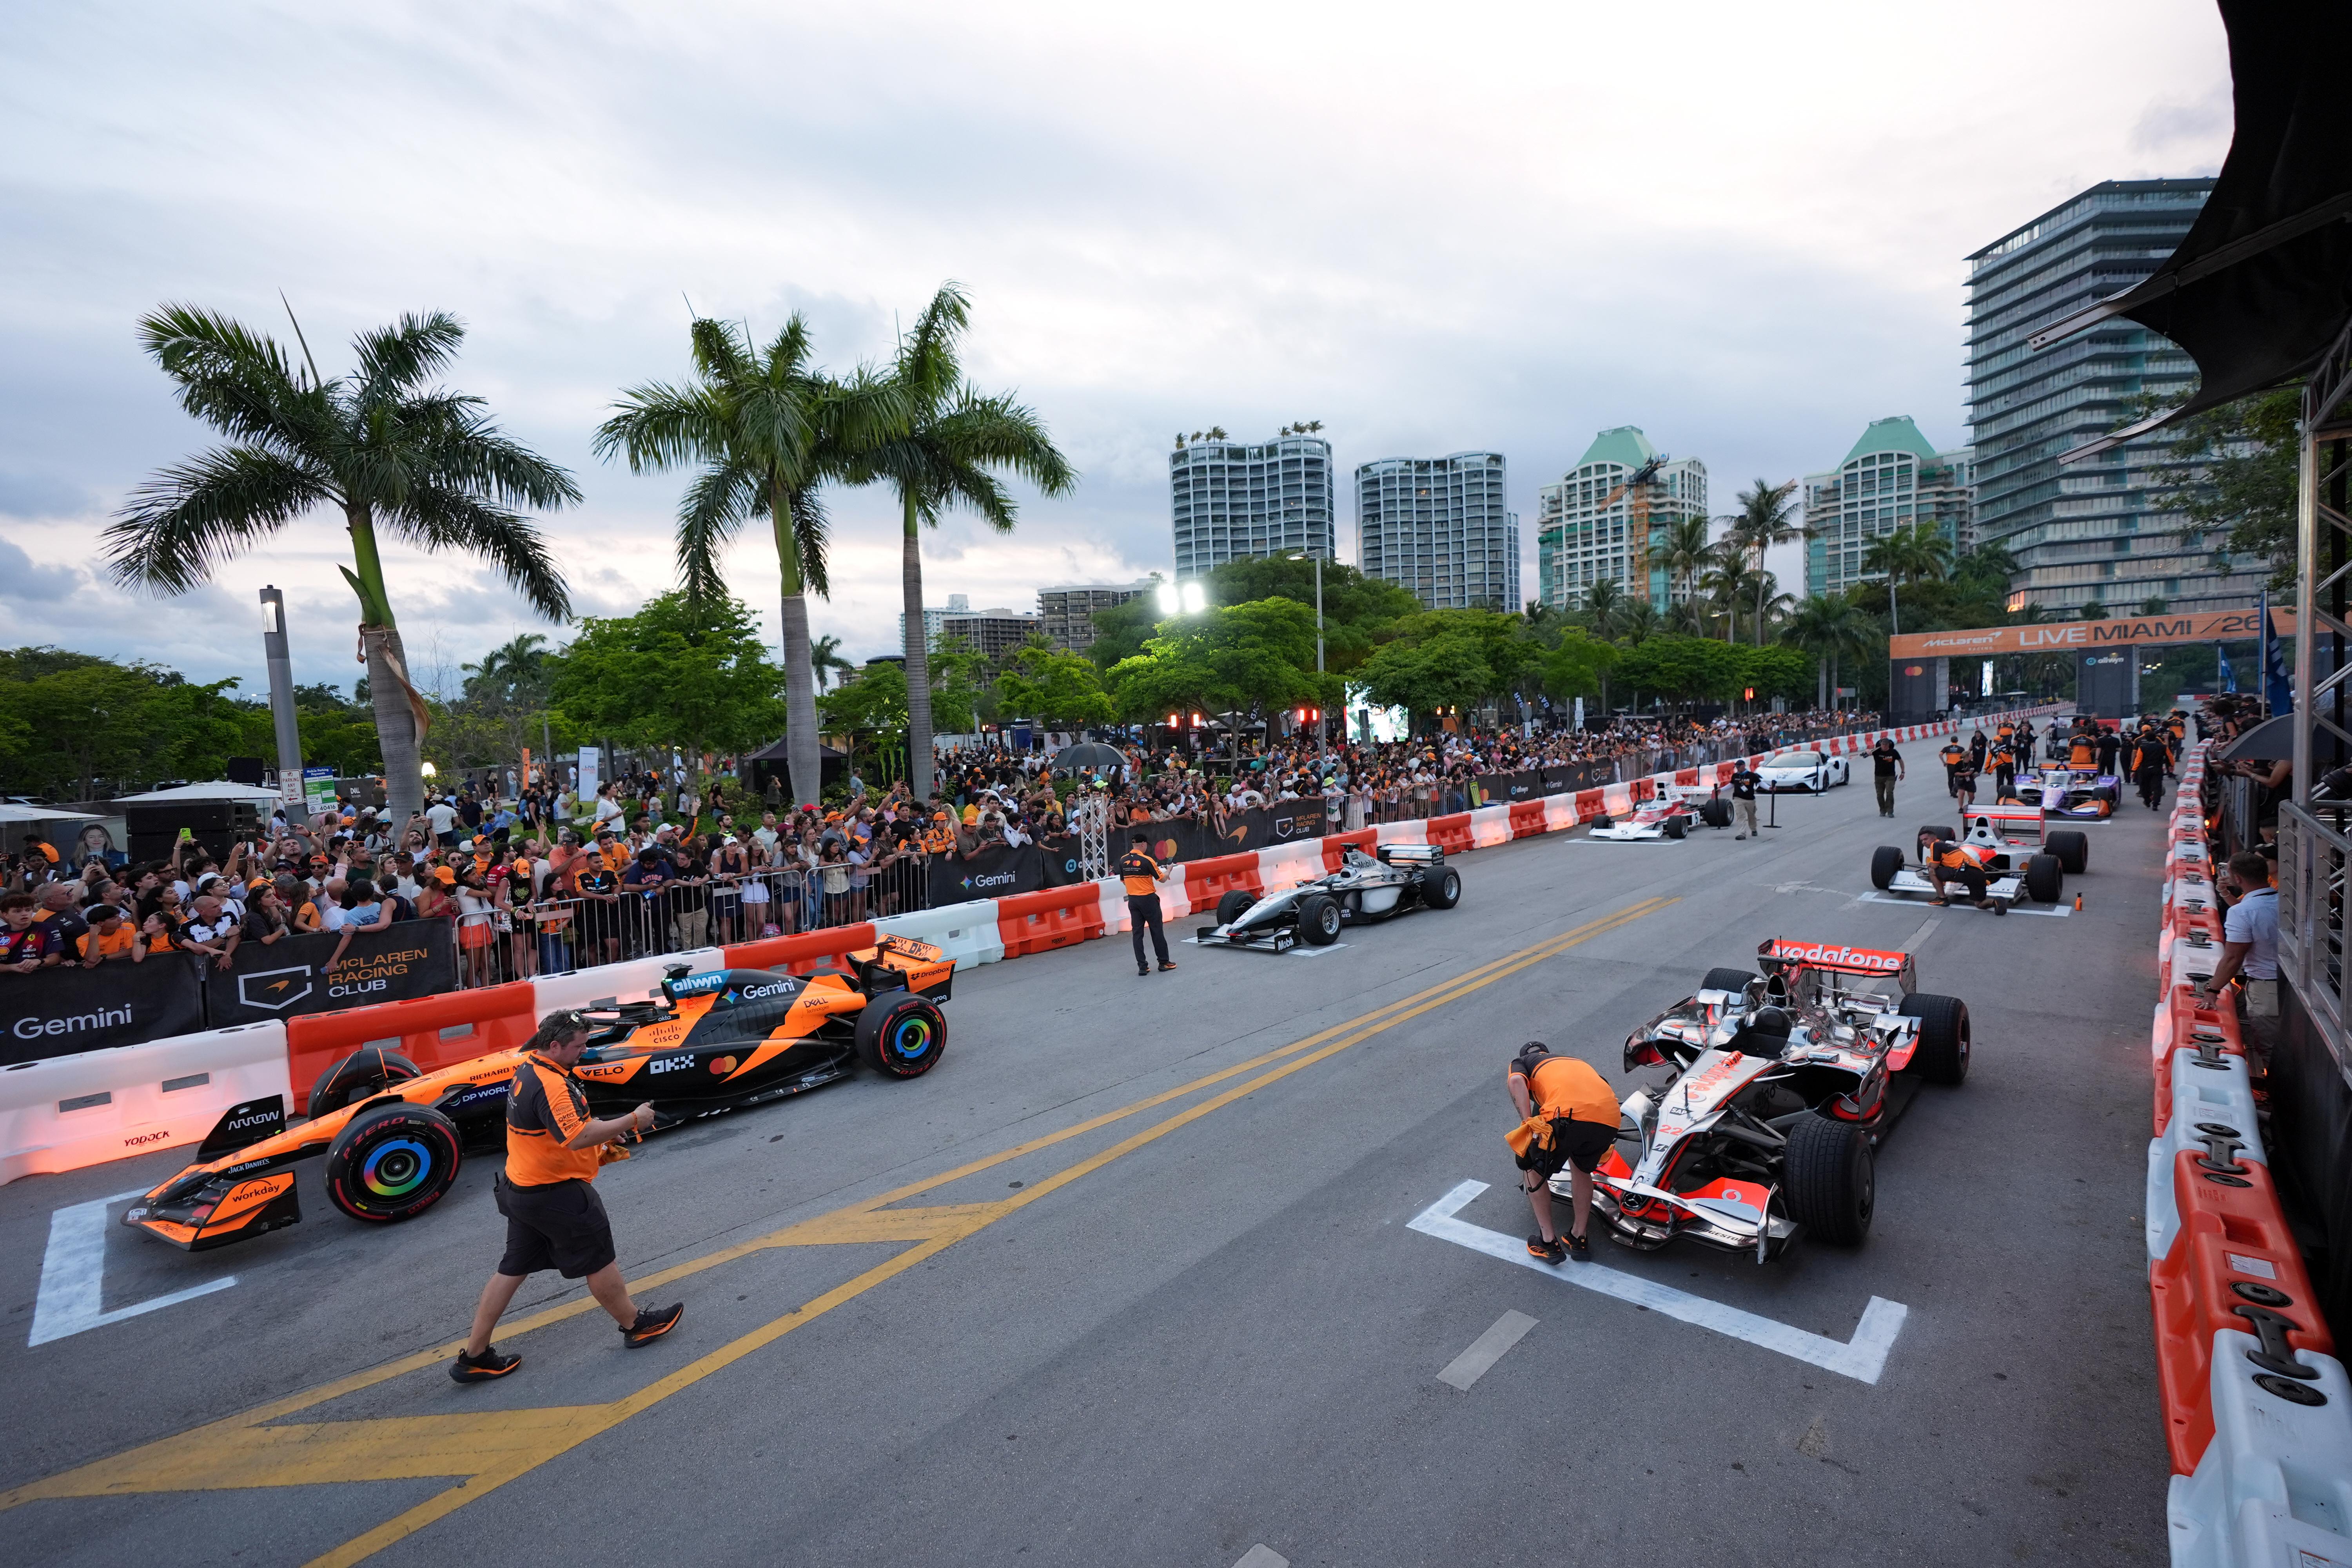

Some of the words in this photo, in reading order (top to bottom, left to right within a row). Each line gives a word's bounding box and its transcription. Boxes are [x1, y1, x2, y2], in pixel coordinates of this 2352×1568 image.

[1922, 636, 1993, 648] McLaren
[2019, 627, 2087, 646] LIVE
[2094, 620, 2192, 641] MIAMI
[2098, 656, 2124, 664] allwyn
[1516, 786, 1528, 794] allwyn
[1549, 780, 1563, 789] Gemini
[1358, 859, 1372, 869] Mobil
[975, 870, 1016, 887] Gemini
[1278, 936, 1294, 951] Mobil
[1774, 944, 1900, 969] vodafone
[328, 964, 408, 985] RACING
[921, 966, 950, 978] Dropbox
[328, 979, 387, 998] CLUB
[672, 975, 722, 992] allwyn
[743, 979, 795, 1000] Gemini
[803, 997, 829, 1008] DELL
[932, 994, 947, 1004] groq
[806, 1005, 830, 1014] Technologies
[13, 1003, 132, 1039] Gemini
[653, 1034, 680, 1044] CISCO
[650, 1054, 695, 1074] OKX
[470, 1067, 510, 1082] RICHARD
[581, 1066, 624, 1078] VELO
[462, 1092, 478, 1102] DP
[555, 1104, 572, 1113] Hilton
[228, 1110, 279, 1131] ARROW
[558, 1112, 575, 1122] okta
[1659, 1124, 1684, 1136] 22
[125, 1131, 170, 1147] YODOCK
[343, 1147, 351, 1160] P
[354, 1116, 406, 1145] ZERO
[228, 1165, 245, 1174] JACK
[245, 1158, 270, 1170] DANIEL'S
[232, 1184, 280, 1202] workday
